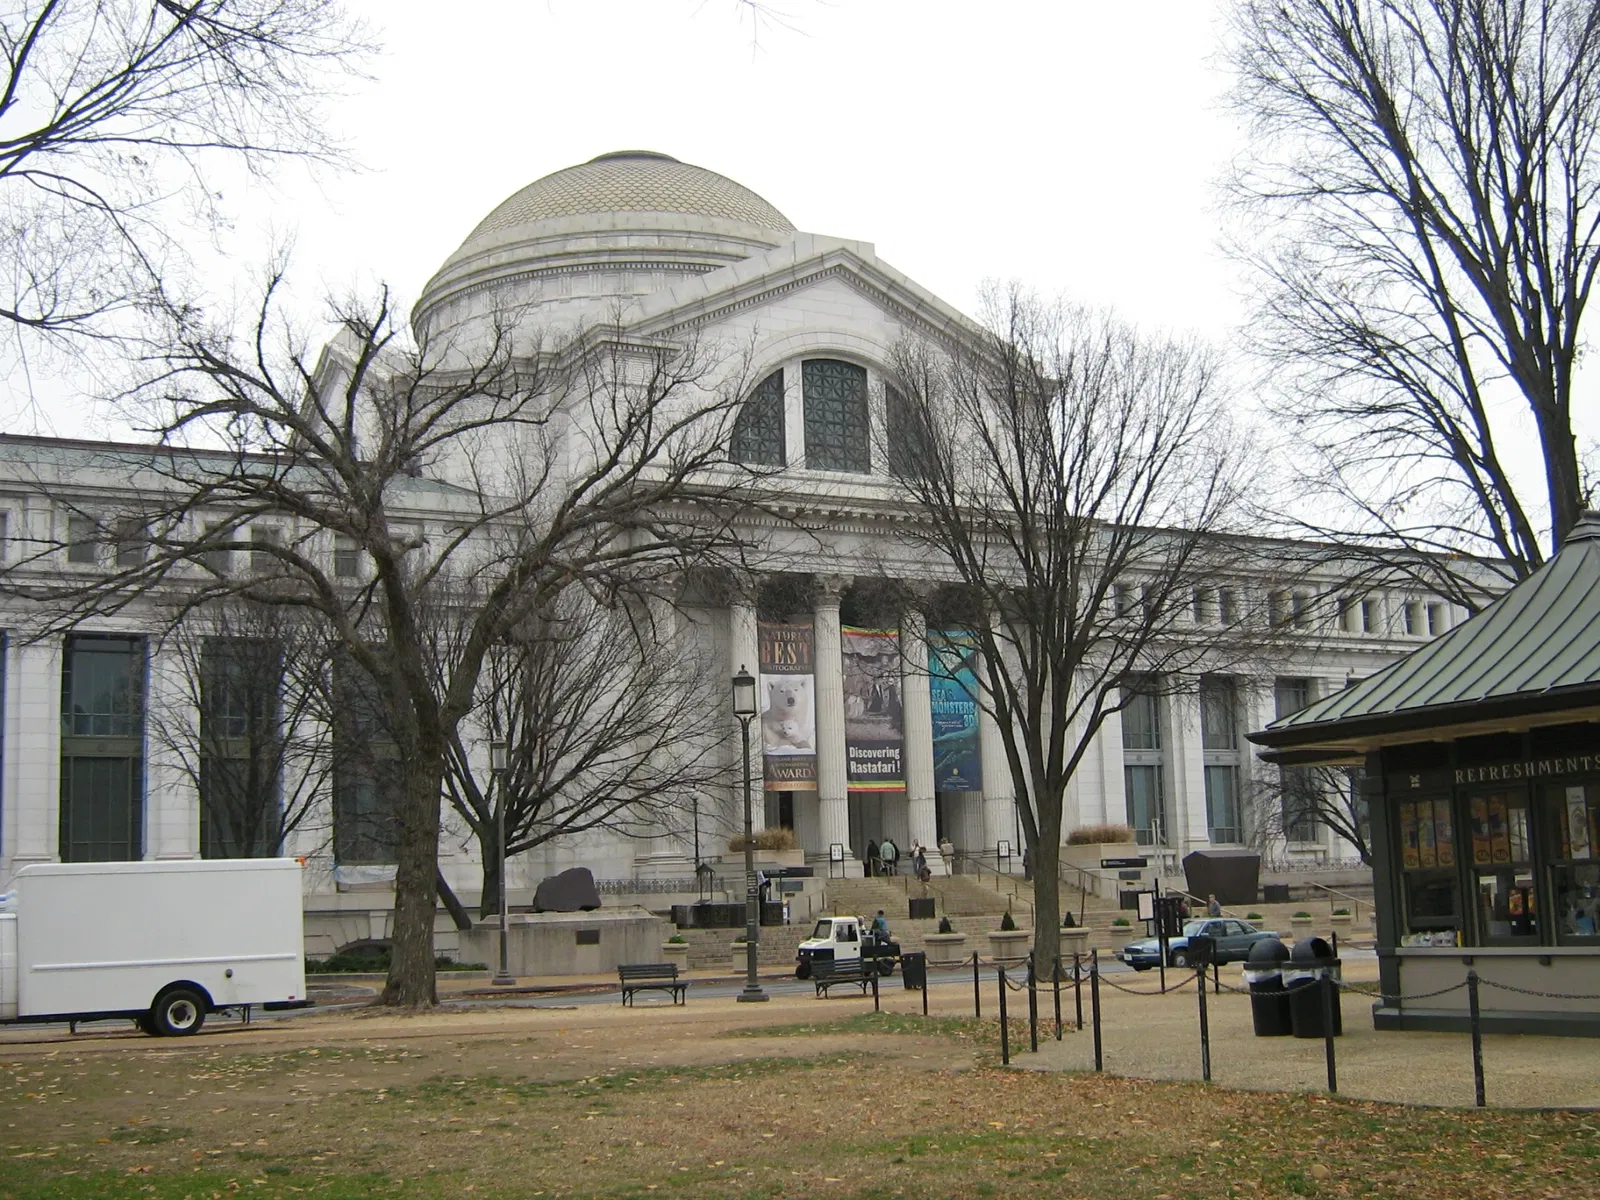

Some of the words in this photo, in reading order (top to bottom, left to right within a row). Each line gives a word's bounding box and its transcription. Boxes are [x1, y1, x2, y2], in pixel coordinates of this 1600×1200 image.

[762, 641, 809, 664] BEST
[931, 689, 947, 701] SEA
[931, 701, 974, 715] MONSTERS
[963, 714, 975, 727] 3D
[849, 746, 900, 760] Discovering
[1455, 754, 1600, 784] REFRESHMENTS
